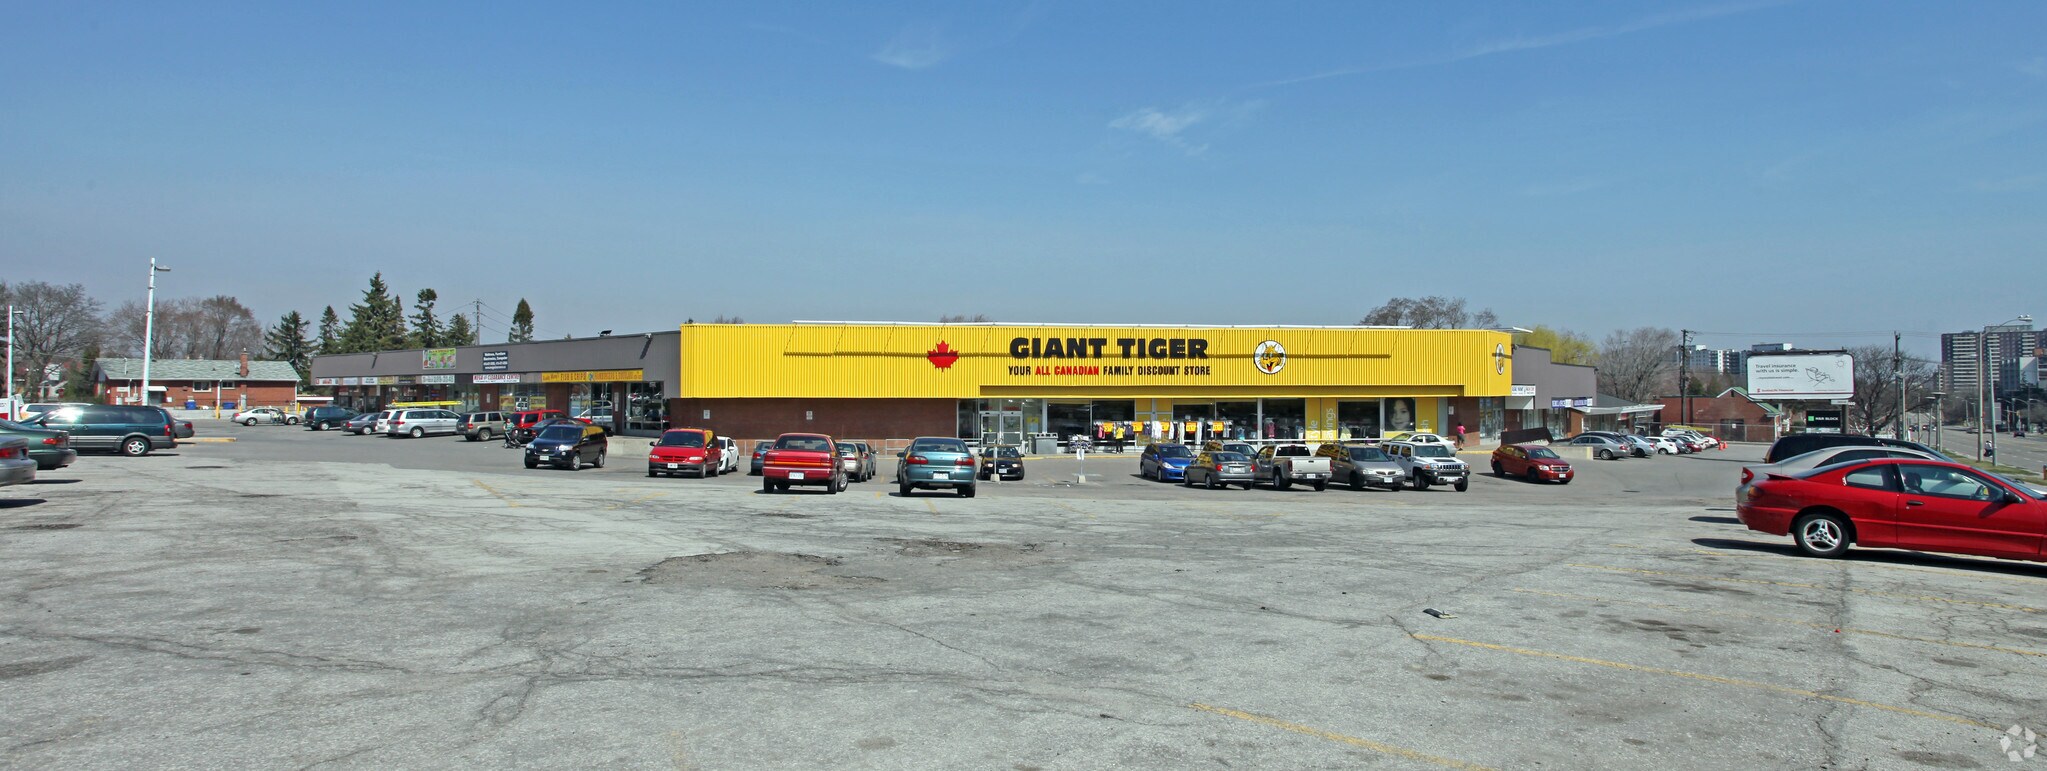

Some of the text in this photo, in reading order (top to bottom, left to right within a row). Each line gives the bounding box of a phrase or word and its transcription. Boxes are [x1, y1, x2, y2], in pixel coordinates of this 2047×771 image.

[1009, 337, 1208, 359] GIANT TIGER
[1008, 365, 1211, 376] YOUR ALL CANADIAN FAMILY DISCOUNT STORE
